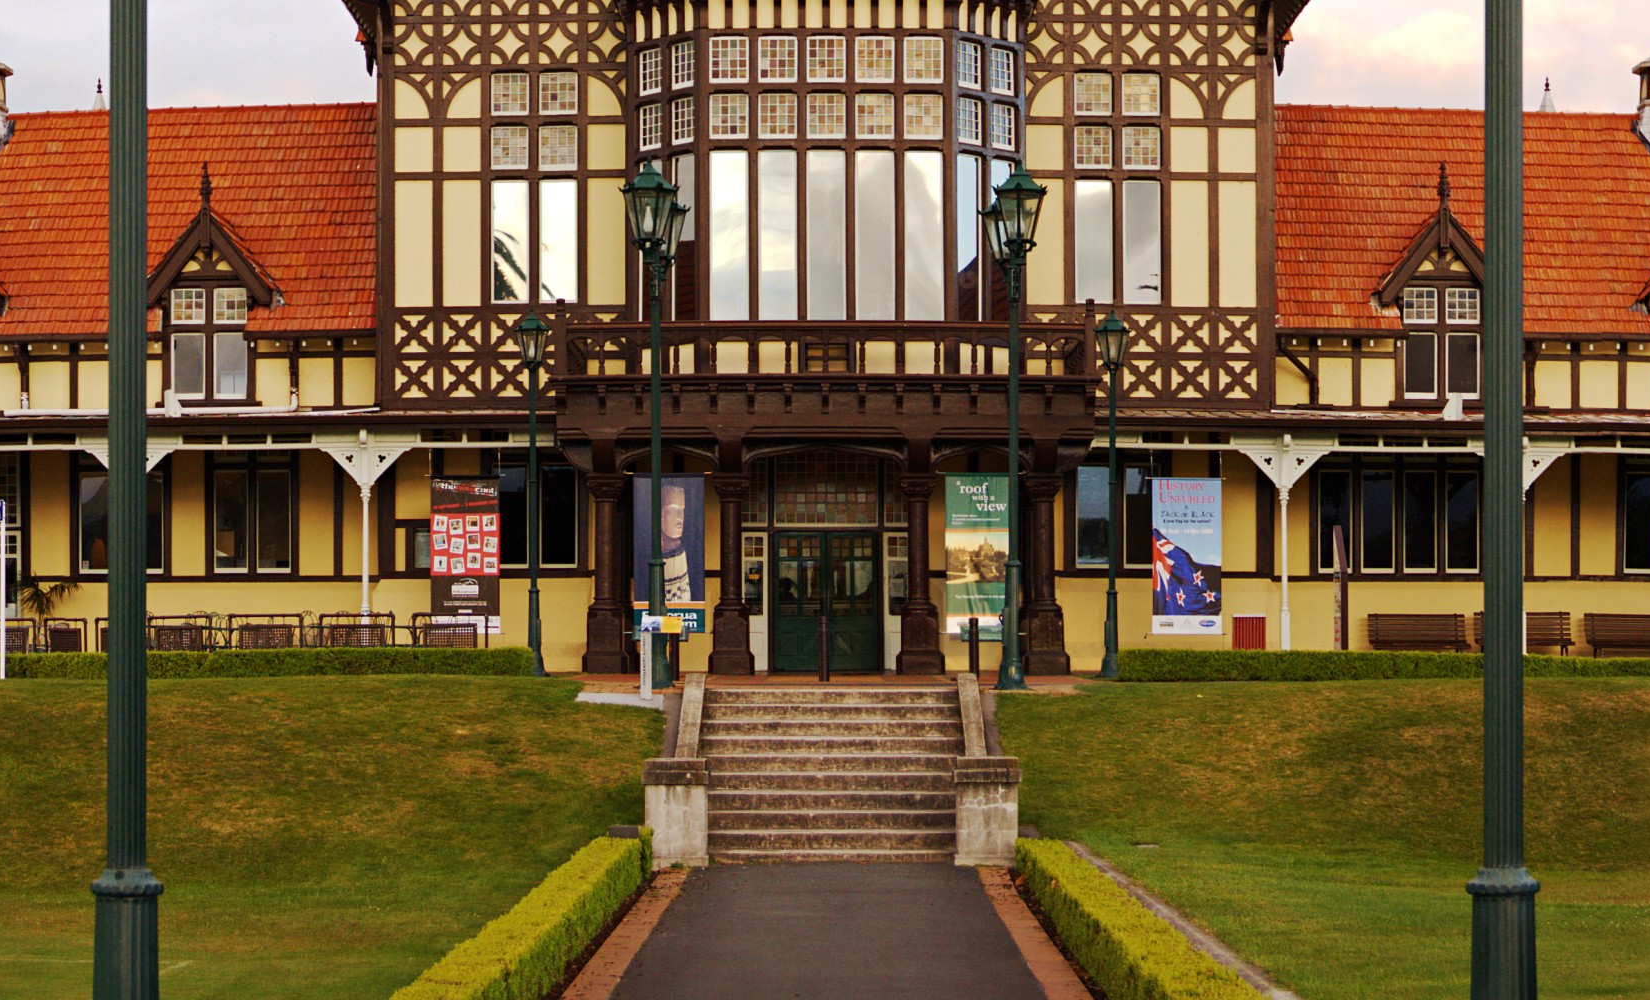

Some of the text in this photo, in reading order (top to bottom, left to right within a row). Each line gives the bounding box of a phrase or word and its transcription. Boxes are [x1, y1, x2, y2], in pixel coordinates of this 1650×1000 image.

[959, 482, 989, 494] roof
[1159, 491, 1216, 504] UNFURLED
[975, 500, 1007, 512] view
[1160, 510, 1180, 518] JACK
[1190, 510, 1215, 518] BLACK
